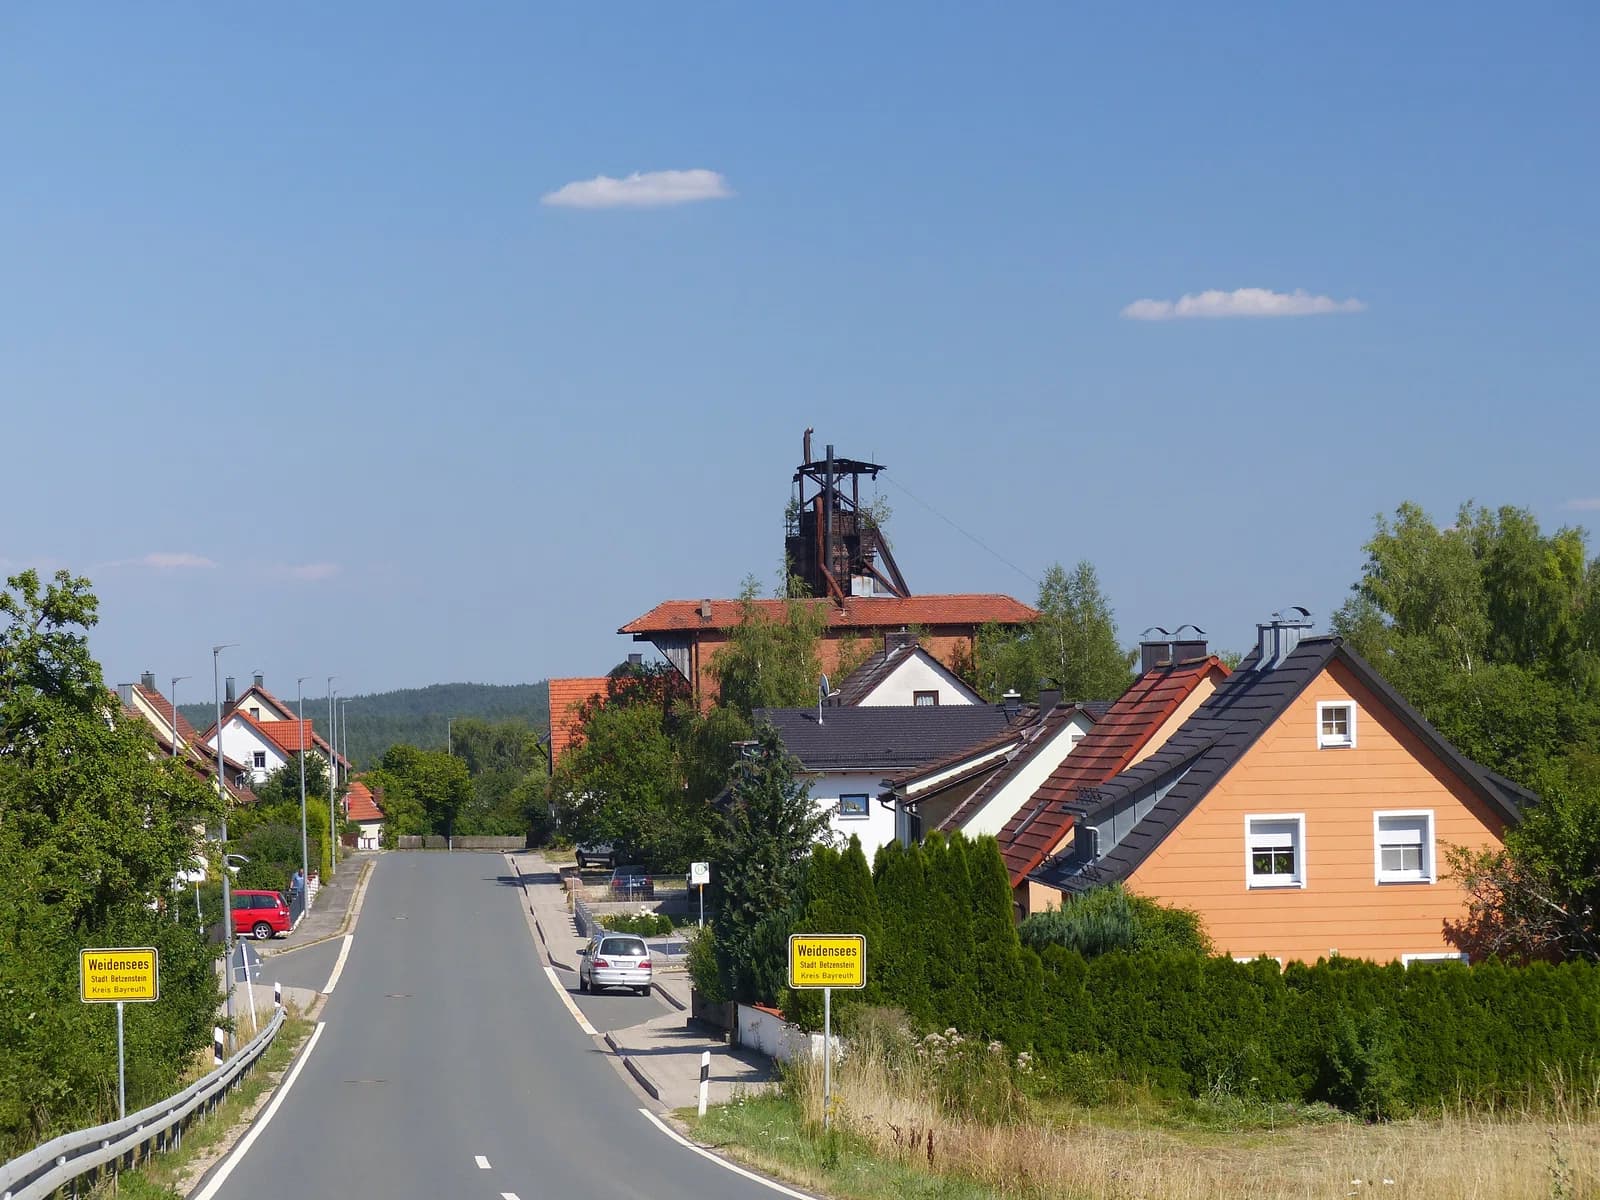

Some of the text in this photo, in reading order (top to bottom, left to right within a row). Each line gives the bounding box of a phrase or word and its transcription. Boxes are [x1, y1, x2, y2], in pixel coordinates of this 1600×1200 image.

[798, 944, 857, 957] Weidensees
[88, 958, 149, 971] Weidensees
[800, 961, 855, 969] Stadt Betzenstein
[91, 975, 147, 983] Stadt Betzenstein
[822, 972, 854, 980] Bayreuth
[114, 986, 146, 994] Bayreuth
